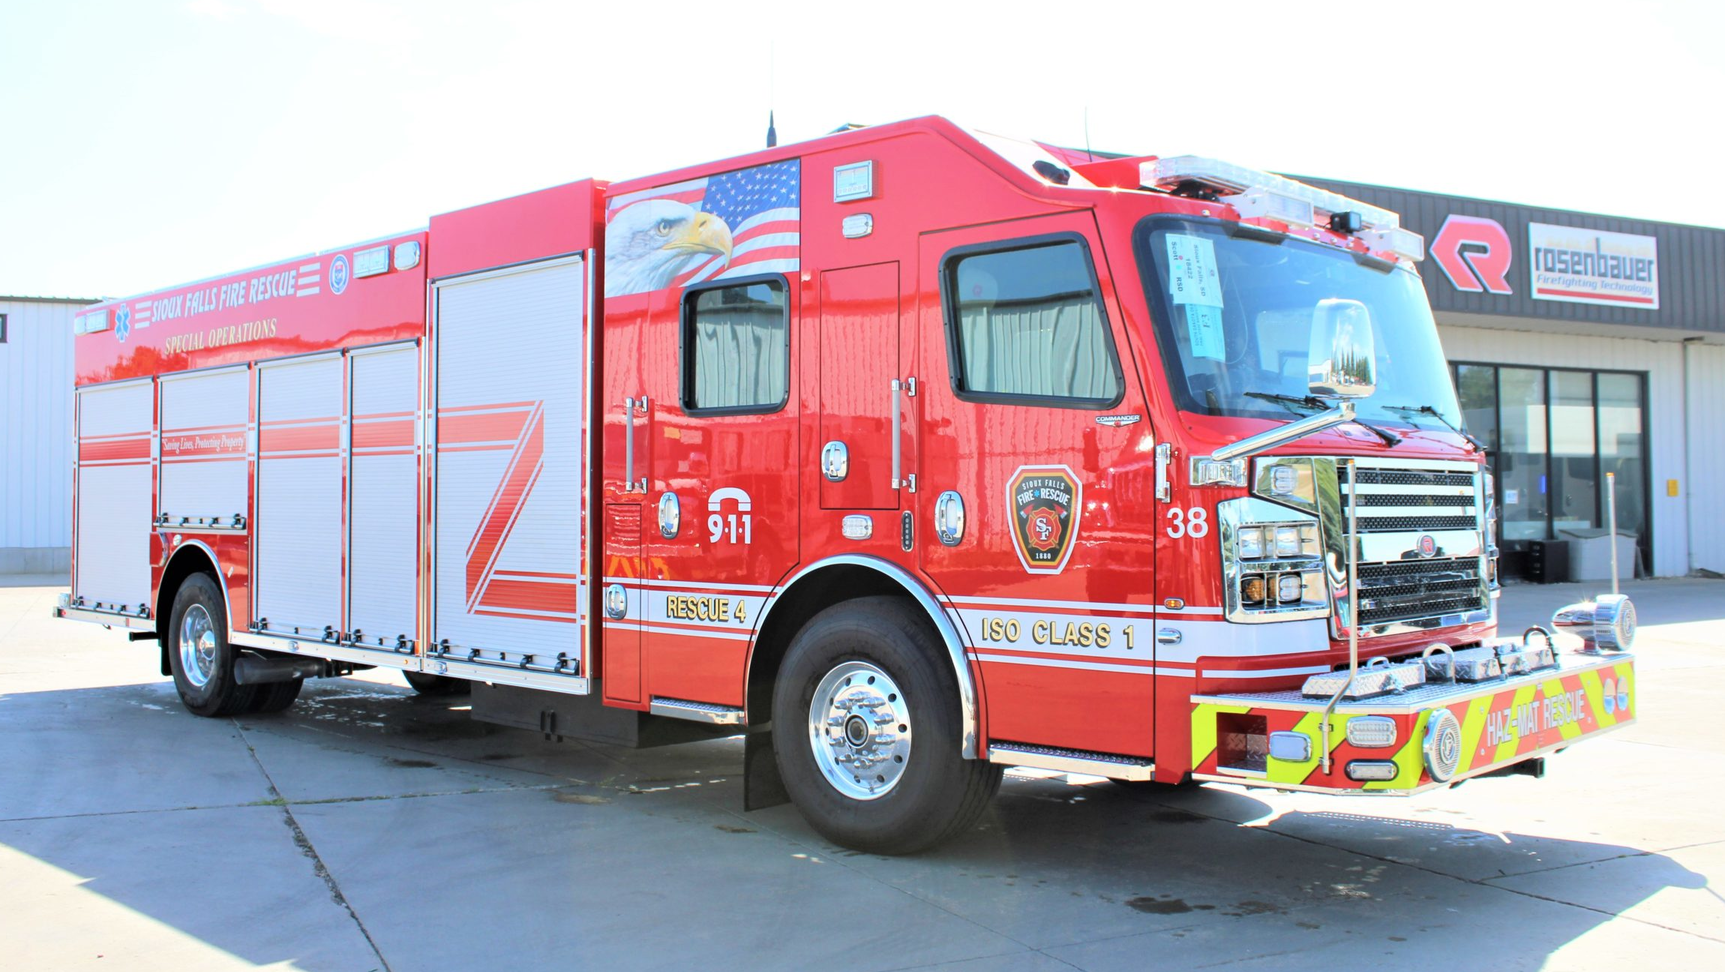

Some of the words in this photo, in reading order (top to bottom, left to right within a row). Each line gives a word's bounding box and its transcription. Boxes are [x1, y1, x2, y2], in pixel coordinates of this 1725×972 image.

[1171, 241, 1179, 261] Scott
[1176, 277, 1184, 292] RSD
[1534, 237, 1655, 283] rosenbauer
[151, 295, 184, 322] SIOUX
[184, 287, 218, 318] FALLS
[219, 281, 247, 311] FIRE
[249, 270, 297, 304] RESCUE
[1537, 274, 1598, 290] Firefighting
[1600, 280, 1654, 296] Technology
[164, 331, 205, 355] SPECIAL
[208, 318, 277, 348] OPERATIONS
[195, 436, 220, 453] Protecting
[1017, 489, 1035, 506] FIRE
[1040, 488, 1070, 506] RESCUE
[1022, 480, 1042, 490] SIOUX
[1045, 480, 1065, 490] FALLS
[1166, 506, 1209, 539] 38
[1035, 552, 1052, 560] 1880
[667, 595, 729, 622] RESCUE
[734, 600, 747, 623] 4
[982, 617, 1021, 643] ISO
[1032, 619, 1111, 649] CLASS
[1123, 624, 1134, 650] 1
[1486, 701, 1541, 747] HAZ-MAT
[1543, 688, 1586, 730] RESCUE
